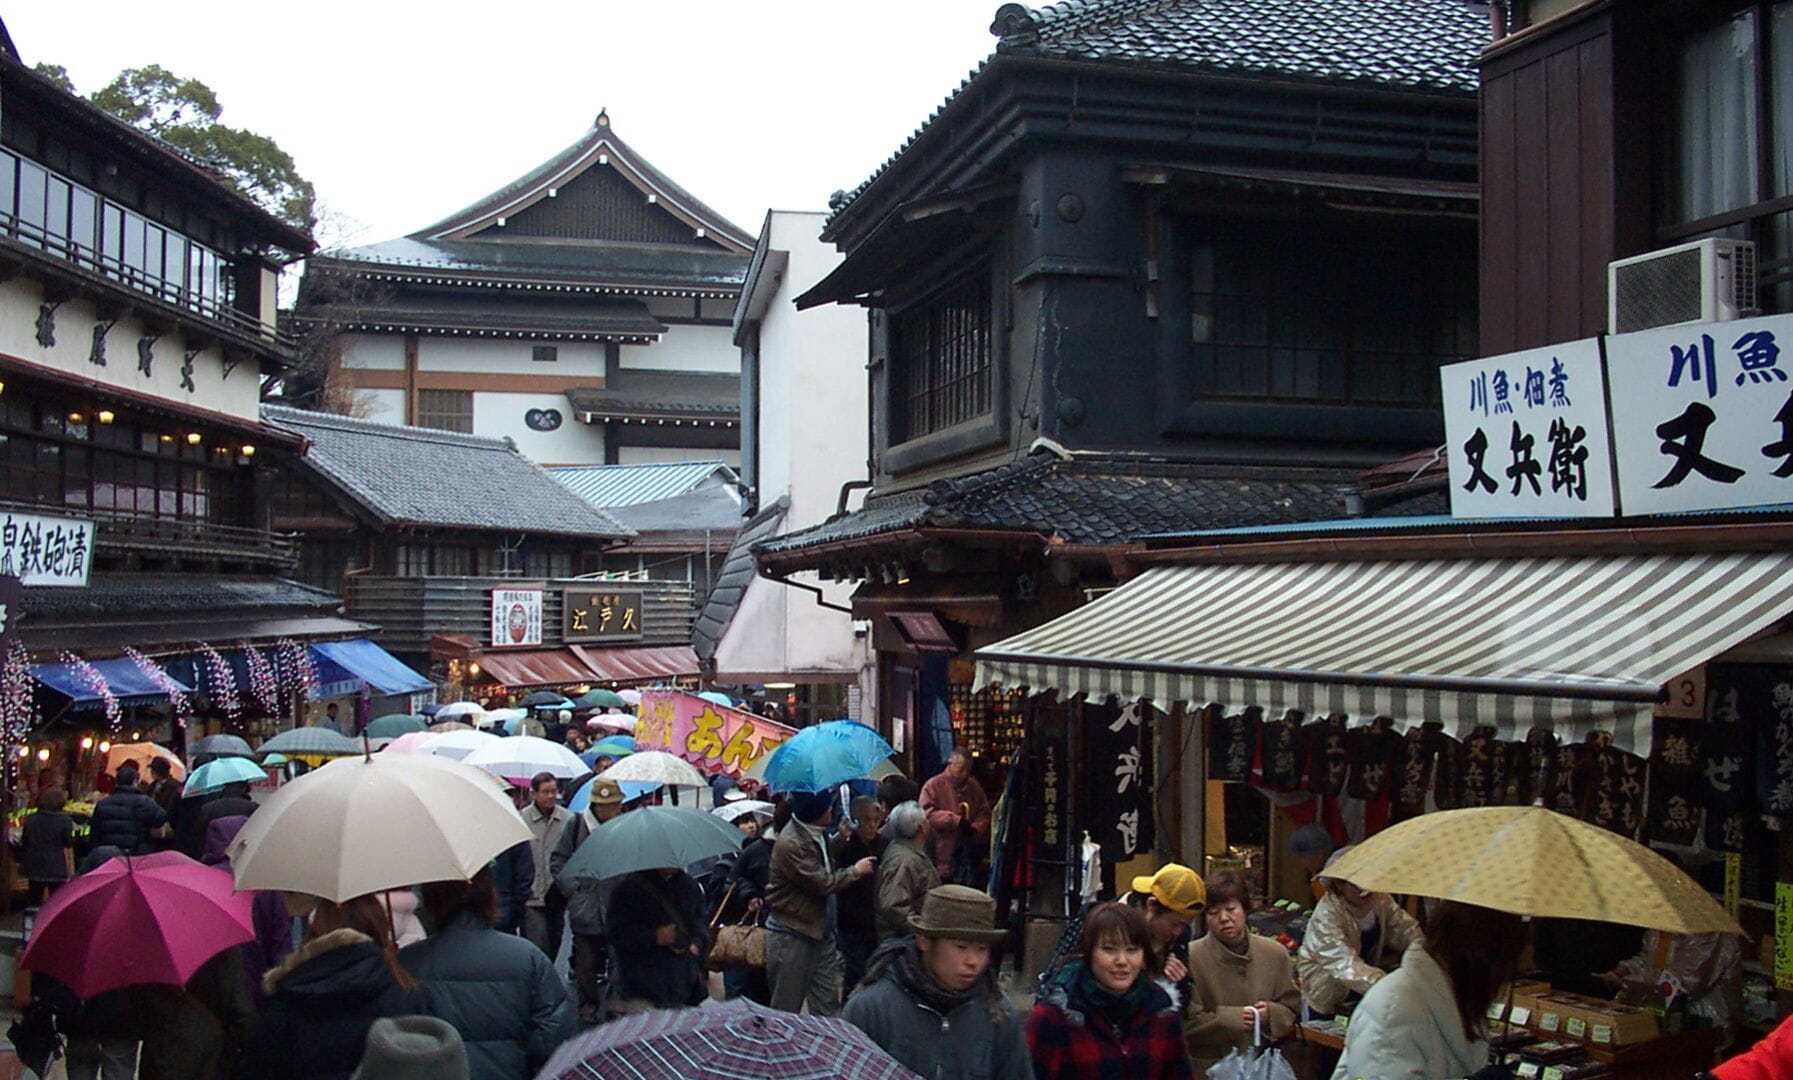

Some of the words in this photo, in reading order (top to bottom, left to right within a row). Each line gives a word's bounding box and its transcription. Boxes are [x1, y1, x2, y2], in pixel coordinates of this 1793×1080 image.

[1470, 356, 1572, 417] 川魚・佃煮
[1667, 331, 1788, 399] 川魚
[1463, 416, 1589, 502] 又兵衛
[572, 606, 637, 633] 江戸久
